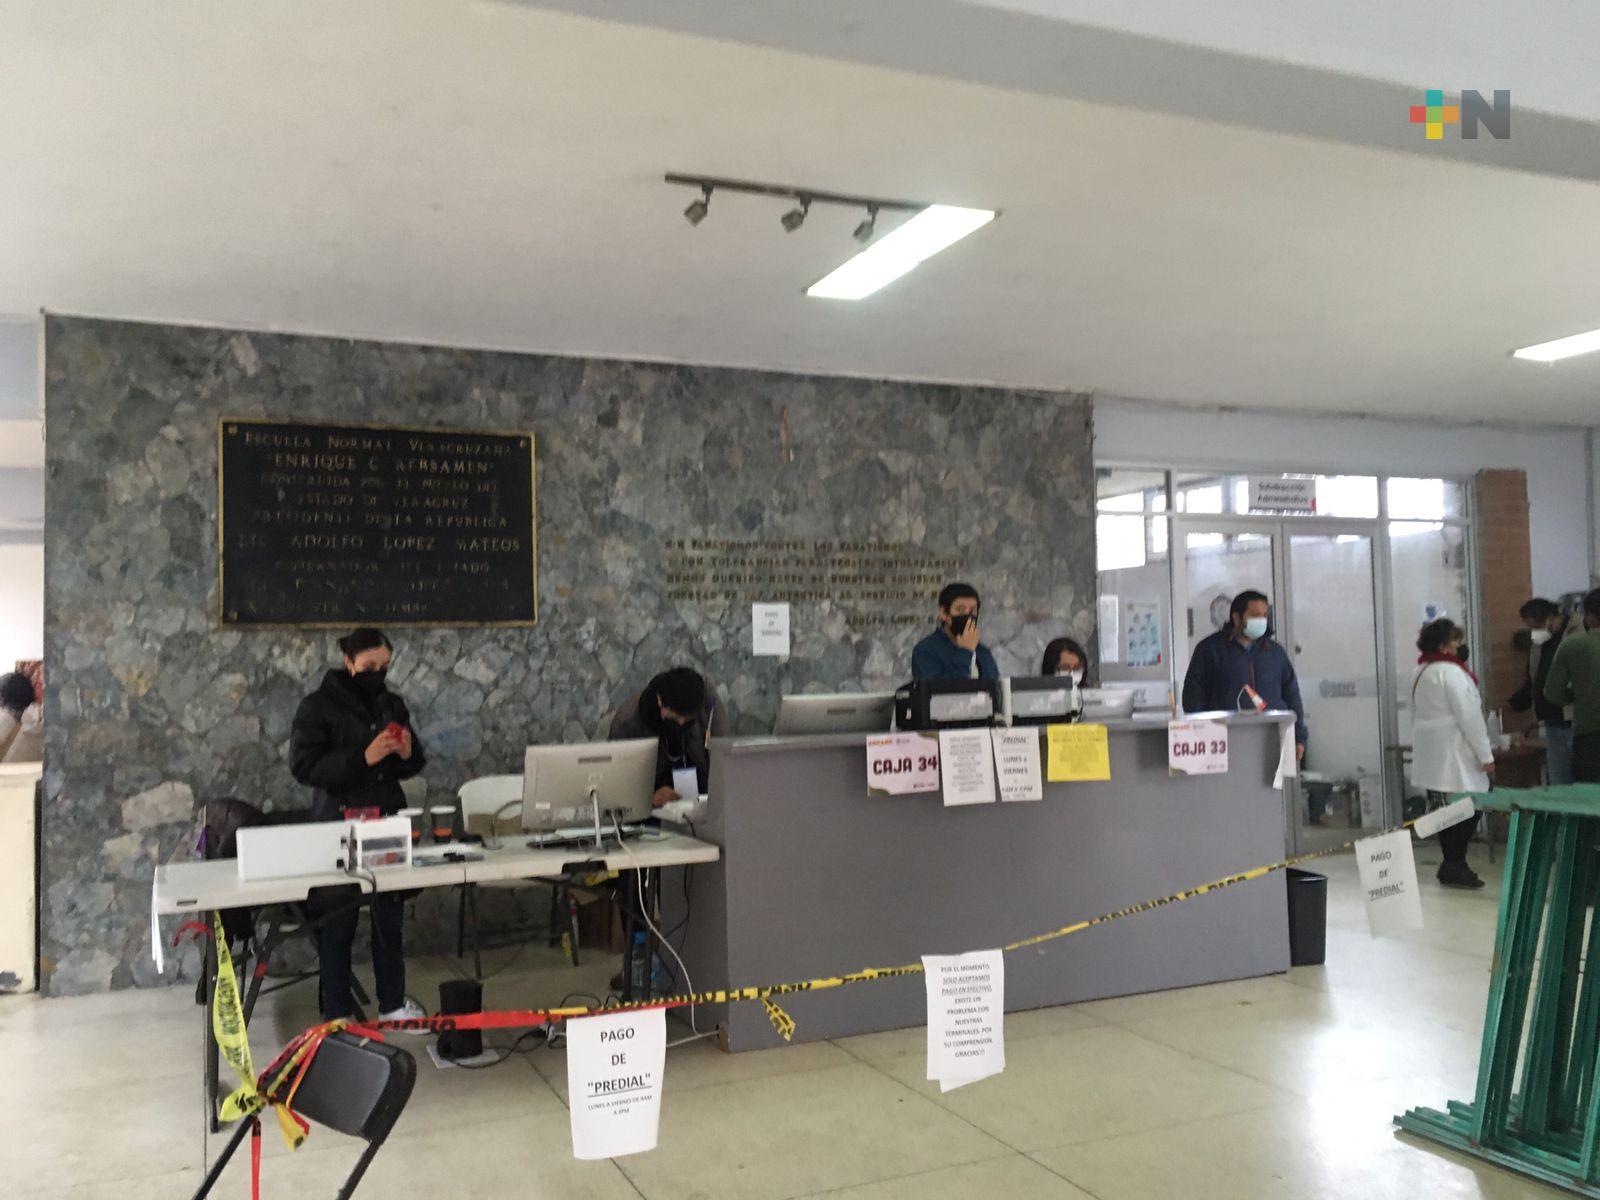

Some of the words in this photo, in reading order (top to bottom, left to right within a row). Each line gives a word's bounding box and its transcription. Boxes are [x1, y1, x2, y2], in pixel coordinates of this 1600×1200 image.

[1173, 742, 1206, 757] CAJA
[1211, 740, 1226, 754] 33
[873, 758, 913, 775] CAJA
[918, 756, 938, 772] 34
[1379, 870, 1388, 879] DE
[960, 963, 990, 972] MOMENTO
[959, 974, 991, 983] ACEPTAMOS
[947, 1008, 978, 1016] PROBLEMA
[955, 1017, 983, 1026] NUESTRAS
[600, 1027, 635, 1043] PAGO
[944, 1041, 952, 1049] SU
[611, 1053, 627, 1067] DE
[587, 1072, 651, 1094] "PREDIAL"
